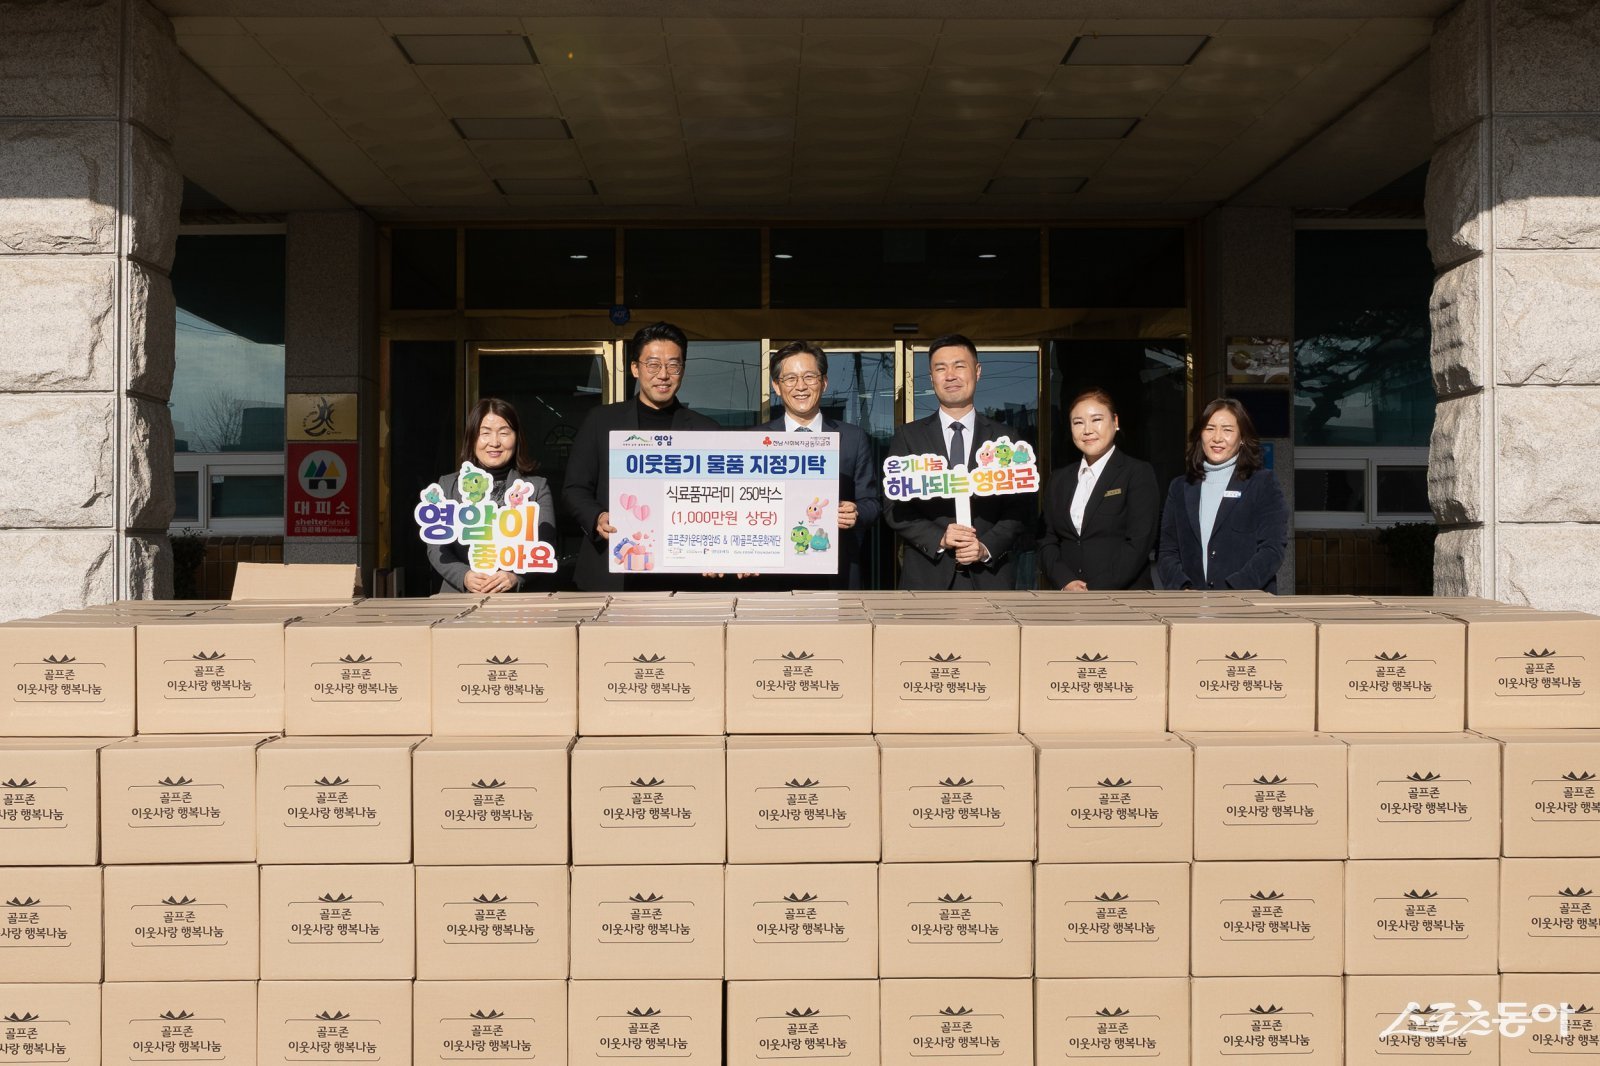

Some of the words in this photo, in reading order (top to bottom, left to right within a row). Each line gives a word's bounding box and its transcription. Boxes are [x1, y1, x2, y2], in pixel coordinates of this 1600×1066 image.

[654, 435, 673, 447] 영암
[626, 454, 701, 475] 이웃돕기
[706, 454, 745, 475] 물품
[749, 454, 827, 475] 지정기탁
[886, 457, 944, 474] 온기나눔
[886, 473, 970, 497] 하나되는
[972, 467, 1036, 492] 영암군
[666, 485, 735, 504] 식료품꾸러미
[739, 485, 784, 504] 250박스
[294, 501, 351, 516] 대피소
[295, 518, 328, 526] shelter
[418, 503, 537, 543] 영암이
[671, 510, 739, 527] (1,000만원
[745, 510, 778, 527] 상당)
[723, 534, 729, 545] &
[730, 534, 782, 547] (재)골프존문화재단
[472, 542, 554, 570] 좋아요
[43, 669, 76, 681] 골프존
[193, 665, 226, 678] 골프존
[340, 668, 372, 681] 골프존
[487, 669, 519, 682] 골프존
[633, 667, 665, 680] 골프존
[782, 665, 814, 678] 골프존
[929, 667, 961, 680] 골프존
[1076, 667, 1108, 680] 골프존
[1225, 665, 1257, 678] 골프존
[1375, 665, 1407, 678] 골프존
[1524, 662, 1556, 675] 골프존
[16, 683, 59, 696] 이웃사랑
[60, 683, 103, 696] 행복나눔
[166, 679, 209, 693] 이웃사랑
[210, 679, 253, 693] 행복나눔
[314, 682, 356, 695] 이웃사랑
[357, 682, 399, 695] 행복나눔
[460, 683, 502, 697] 이웃사랑
[503, 683, 545, 697] 행복나눔
[607, 682, 649, 695] 이웃사랑
[650, 682, 692, 695] 행복나눔
[755, 679, 798, 692] 이웃사랑
[798, 679, 841, 692] 행복나눔
[902, 681, 945, 694] 이웃사랑
[946, 681, 988, 694] 행복나눔
[1050, 681, 1092, 694] 이웃사랑
[1093, 681, 1135, 694] 행복나눔
[1199, 679, 1241, 692] 이웃사랑
[1242, 679, 1284, 692] 행복나눔
[1348, 680, 1390, 693] 이웃사랑
[1391, 680, 1433, 693] 행복나눔
[1498, 676, 1540, 690] 이웃사랑
[1541, 676, 1582, 690] 행복나눔
[159, 791, 193, 805] 골프존
[315, 791, 349, 805] 골프존
[631, 792, 665, 805] 골프존
[786, 793, 819, 806] 골프존
[940, 792, 974, 805] 골프존
[1098, 792, 1132, 806] 골프존
[1254, 790, 1287, 803] 골프존
[1407, 786, 1441, 800] 골프존
[1562, 786, 1596, 799] 골프존
[2, 793, 36, 807] 골프존
[472, 793, 506, 807] 골프존
[20, 808, 65, 822] 행복나눔
[131, 806, 176, 820] 이웃사랑
[177, 806, 222, 820] 행복나눔
[287, 806, 332, 820] 이웃사랑
[333, 806, 377, 820] 행복나눔
[444, 808, 489, 822] 이웃사랑
[490, 808, 534, 822] 행복나눔
[603, 807, 647, 821] 이웃사랑
[648, 807, 693, 821] 행복나눔
[758, 807, 802, 822] 이웃사랑
[803, 807, 848, 822] 행복나눔
[912, 807, 956, 821] 이웃사랑
[957, 807, 1002, 821] 행복나눔
[1070, 807, 1115, 821] 이웃사랑
[1115, 807, 1160, 821] 행복나눔
[1226, 804, 1270, 818] 이웃사랑
[1271, 804, 1315, 818] 행복나눔
[1379, 801, 1424, 815] 이웃사랑
[1425, 801, 1469, 815] 행복나눔
[1534, 801, 1579, 815] 이웃사랑
[319, 908, 353, 921] 골프존
[474, 908, 508, 922] 골프존
[629, 907, 663, 921] 골프존
[784, 907, 818, 921] 골프존
[938, 908, 972, 921] 골프존
[1095, 906, 1129, 920] 골프존
[1250, 905, 1284, 919] 골프존
[1404, 904, 1438, 917] 골프존
[1559, 902, 1592, 915] 골프존
[7, 912, 40, 925] 골프존
[162, 910, 196, 924] 골프존
[1530, 917, 1575, 931] 이웃사랑
[134, 925, 179, 940] 이웃사랑
[180, 925, 225, 940] 행복나눔
[291, 923, 335, 937] 이웃사랑
[336, 923, 381, 937] 행복나눔
[446, 923, 490, 937] 이웃사랑
[491, 923, 536, 937] 행복나눔
[601, 922, 646, 936] 이웃사랑
[647, 922, 691, 936] 행복나눔
[756, 922, 801, 936] 이웃사랑
[801, 922, 846, 936] 행복나눔
[910, 923, 955, 937] 이웃사랑
[956, 923, 1000, 937] 행복나눔
[1067, 921, 1111, 935] 이웃사랑
[1112, 921, 1156, 935] 행복나눔
[1223, 920, 1267, 934] 이웃사랑
[1268, 920, 1312, 934] 행복나눔
[1376, 919, 1420, 932] 이웃사랑
[1421, 919, 1466, 932] 행복나눔
[24, 927, 69, 941] 행복나눔
[160, 1025, 194, 1039] 골프존
[316, 1025, 350, 1039] 골프존
[471, 1024, 504, 1038] 골프존
[627, 1022, 661, 1035] 골프존
[786, 1022, 820, 1036] 골프존
[940, 1020, 973, 1034] 골프존
[1096, 1022, 1129, 1035] 골프존
[1250, 1019, 1283, 1033] 골프존
[4, 1027, 39, 1041] 골프존
[1223, 1033, 1266, 1048] 이웃사랑
[1267, 1033, 1311, 1048] 행복나눔
[22, 1042, 67, 1056] 행복나눔
[132, 1040, 177, 1054] 이웃사랑
[178, 1040, 223, 1054] 행복나눔
[288, 1040, 332, 1054] 이웃사랑
[333, 1040, 378, 1054] 행복나눔
[443, 1039, 487, 1053] 이웃사랑
[488, 1039, 532, 1053] 행복나눔
[599, 1037, 644, 1050] 이웃사랑
[644, 1037, 689, 1050] 행복나눔
[759, 1037, 803, 1052] 이웃사랑
[804, 1037, 848, 1052] 행복나눔
[912, 1035, 956, 1049] 이웃사랑
[957, 1035, 1001, 1049] 행복나눔
[1068, 1037, 1112, 1051] 이웃사랑
[1114, 1037, 1157, 1051] 행복나눔
